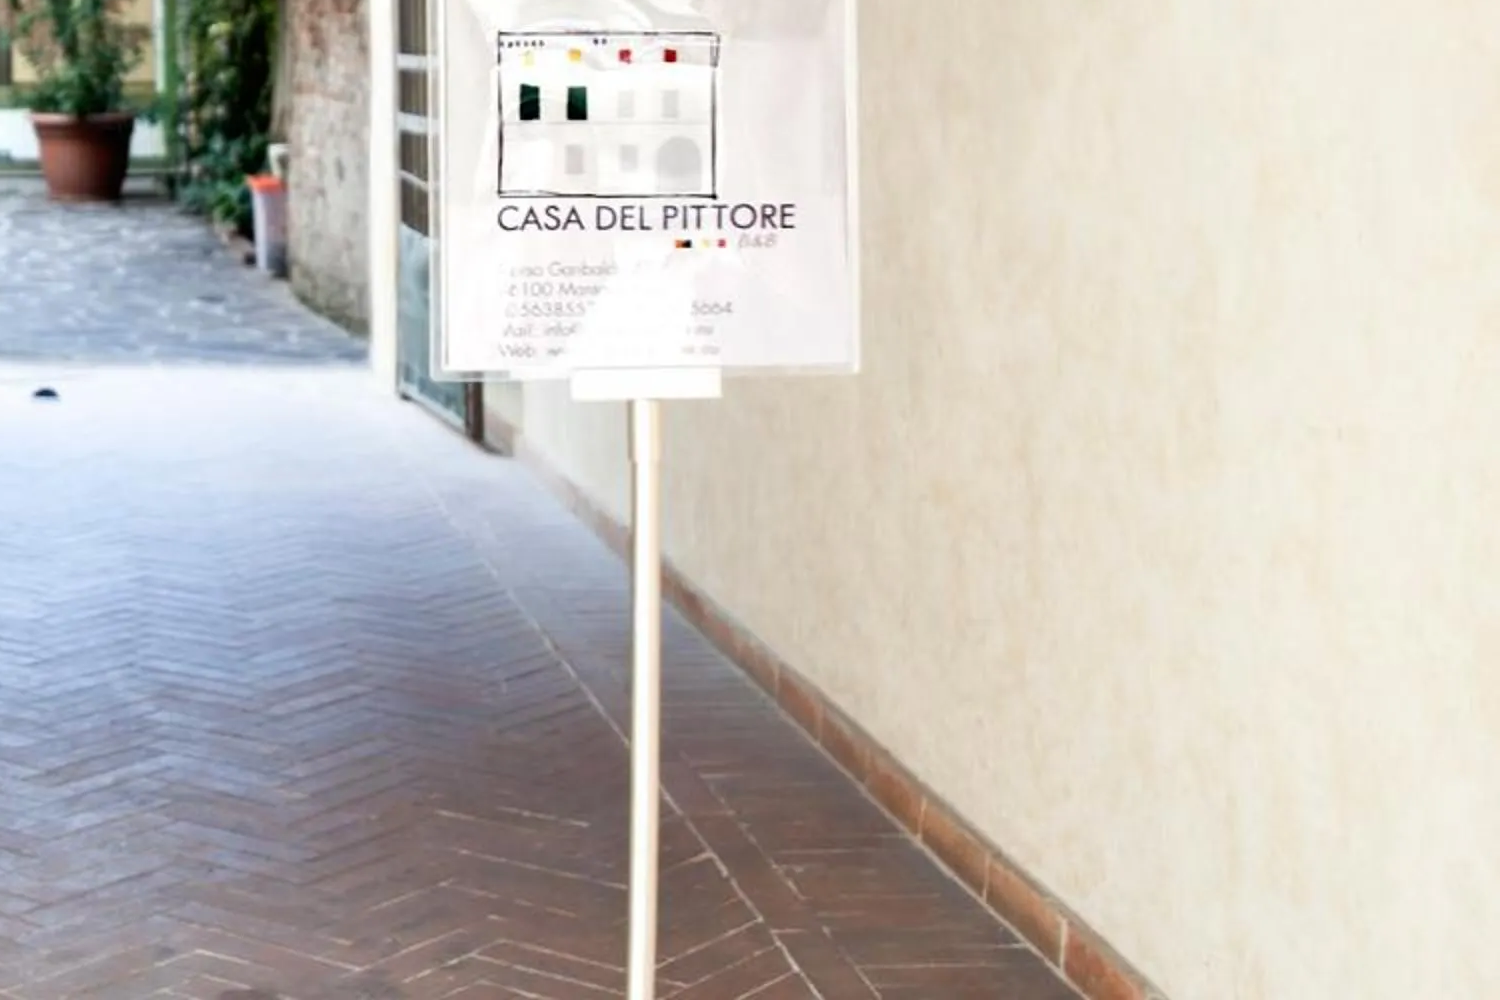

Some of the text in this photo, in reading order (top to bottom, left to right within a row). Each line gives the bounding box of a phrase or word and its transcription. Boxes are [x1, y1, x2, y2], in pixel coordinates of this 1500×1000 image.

[497, 203, 797, 231] CASA DEL PITTORE
